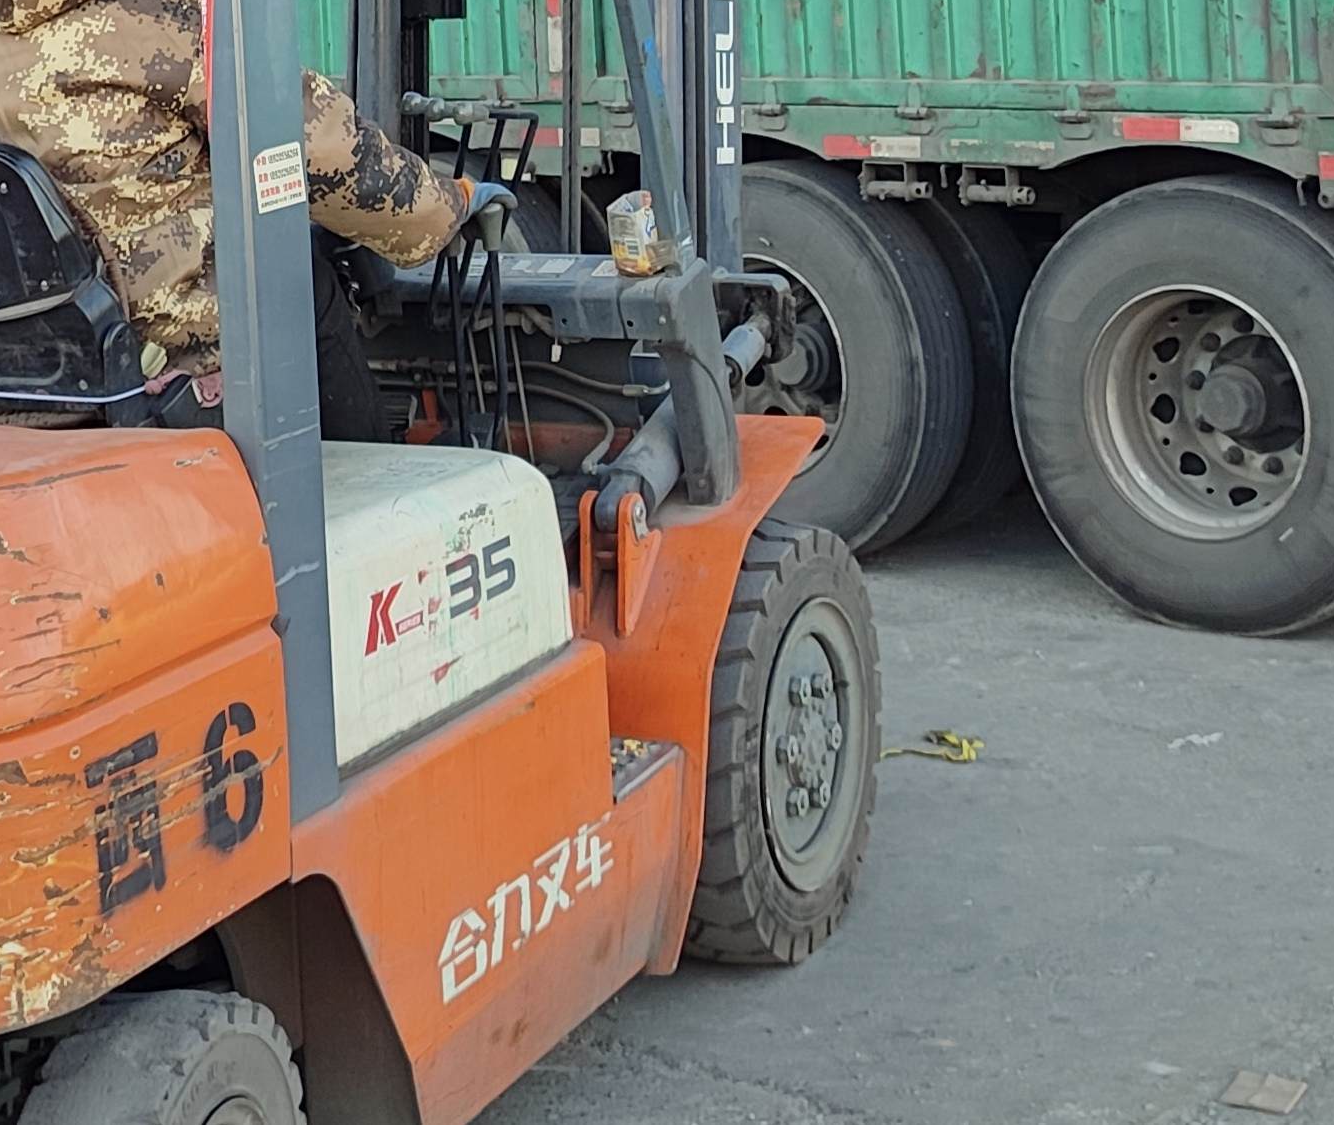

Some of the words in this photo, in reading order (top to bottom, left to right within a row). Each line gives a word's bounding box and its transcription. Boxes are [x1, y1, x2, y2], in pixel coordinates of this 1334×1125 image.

[445, 535, 516, 619] 35
[438, 810, 614, 1007] 合力叉车
